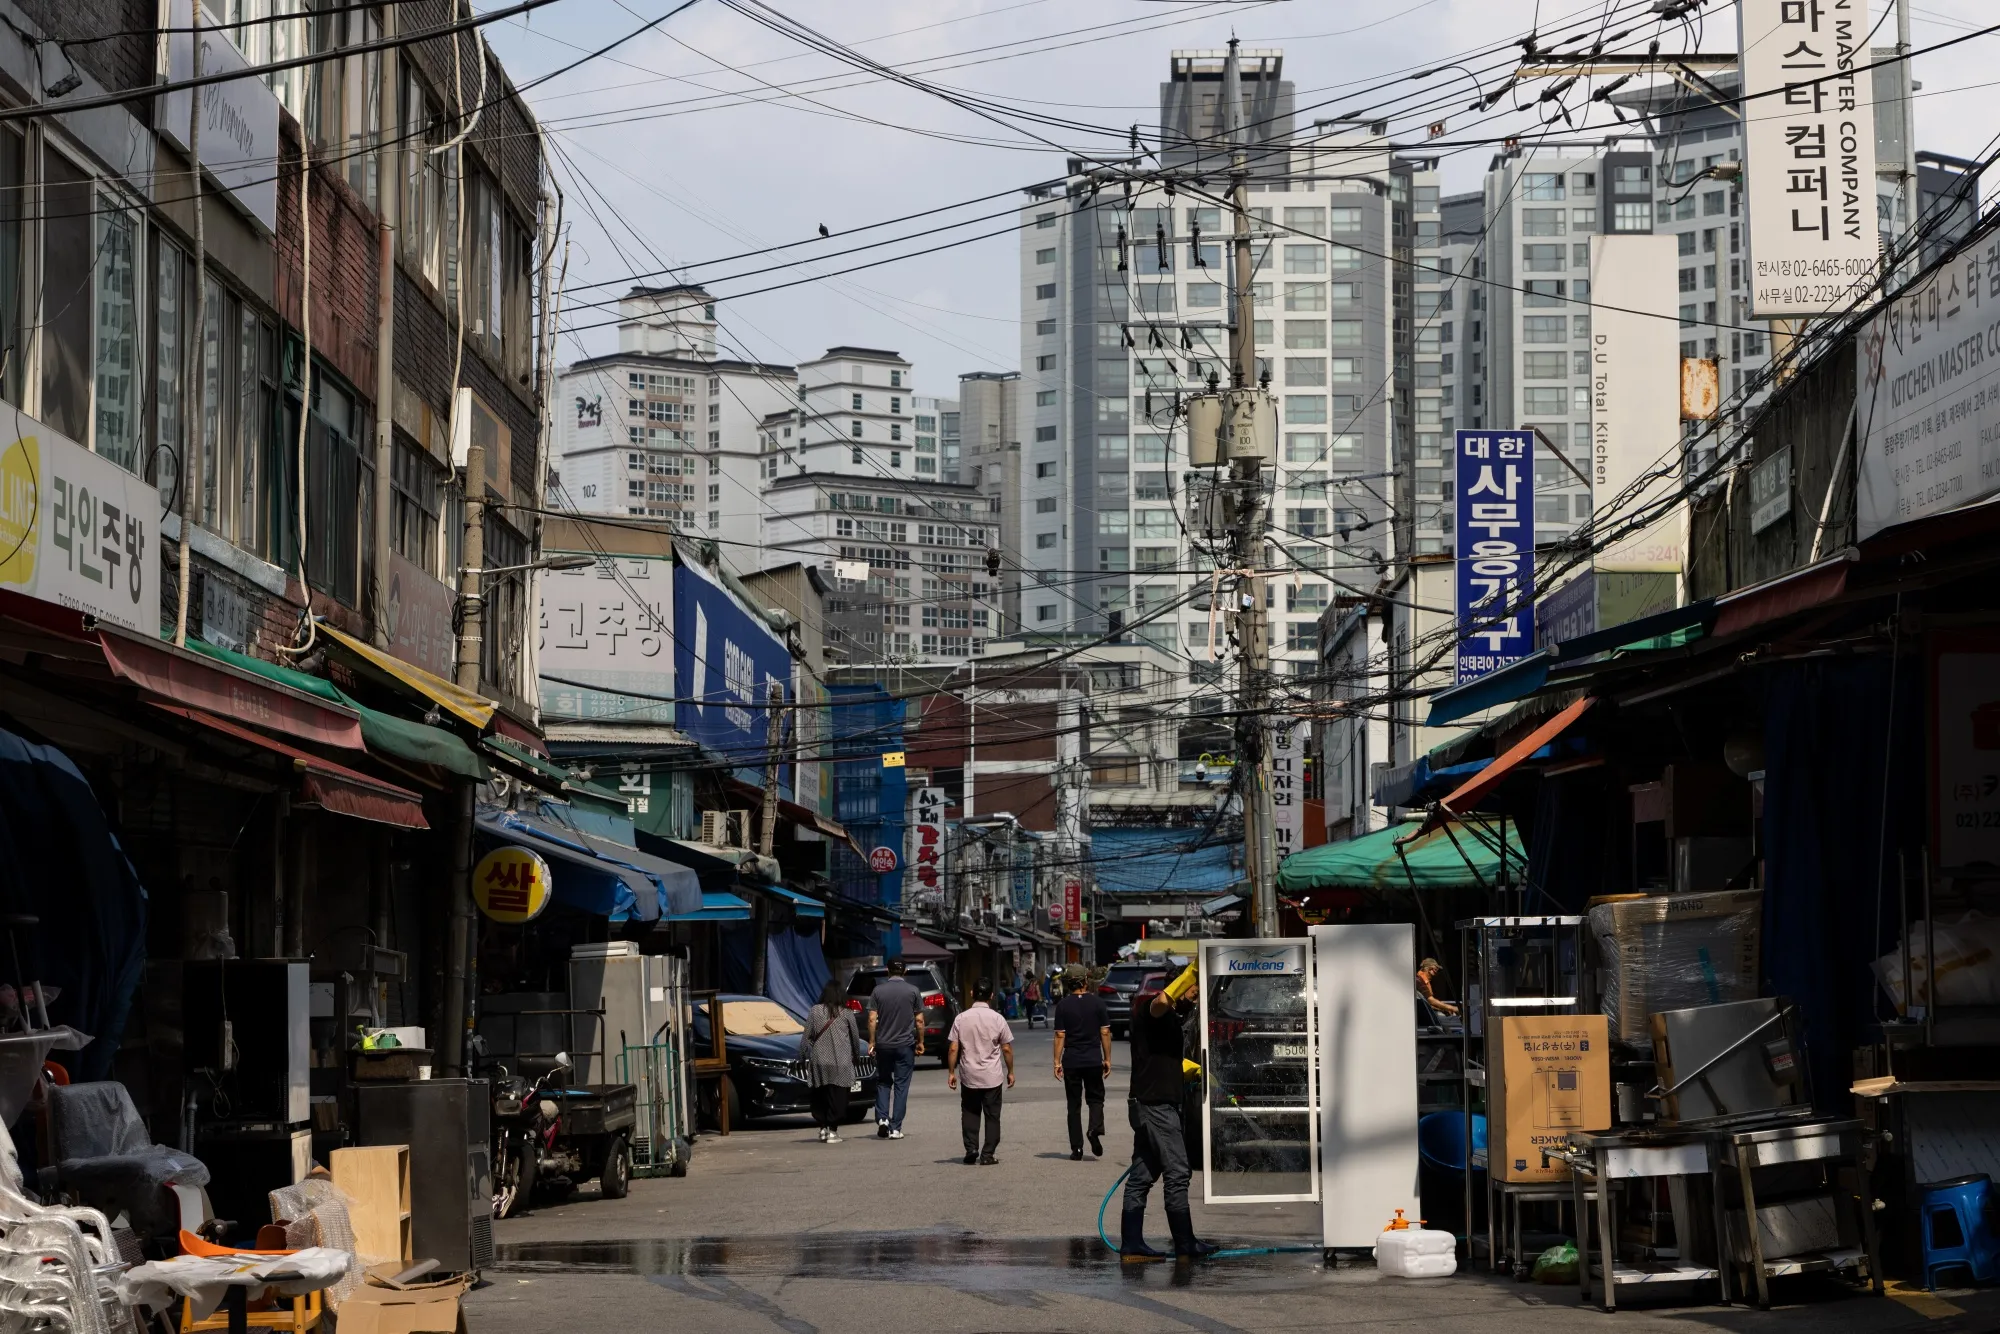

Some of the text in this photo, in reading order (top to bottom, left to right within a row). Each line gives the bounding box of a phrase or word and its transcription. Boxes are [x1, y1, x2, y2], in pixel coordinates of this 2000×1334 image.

[1835, 20, 1855, 113] MASTER
[1839, 121, 1861, 240] COMPANY
[1757, 260, 1792, 278] 전시장
[1758, 287, 1793, 305] 사무실
[1891, 358, 1935, 410] KITCHEN
[1939, 332, 1985, 385] MASTER
[1594, 334, 1609, 485] D.U Total Kitchen
[1464, 437, 1526, 459] 대한
[1926, 440, 1962, 471] 02-6465-6002
[582, 486, 597, 498] 102
[1926, 474, 1963, 504] 02-2234-7700
[53, 475, 145, 605] 라인주방
[1466, 464, 1523, 652] 사무용가구
[399, 597, 453, 672] 스마일 유통
[540, 598, 664, 658] 고주방
[1459, 655, 1495, 672] 인테리어
[1273, 758, 1293, 806] 디자인
[871, 856, 893, 869] 여인숙
[484, 861, 536, 912] 쌀
[1228, 960, 1285, 971] Kumkang
[1523, 1041, 1576, 1052] (주)우성기업
[1530, 1136, 1567, 1145] MAKER
